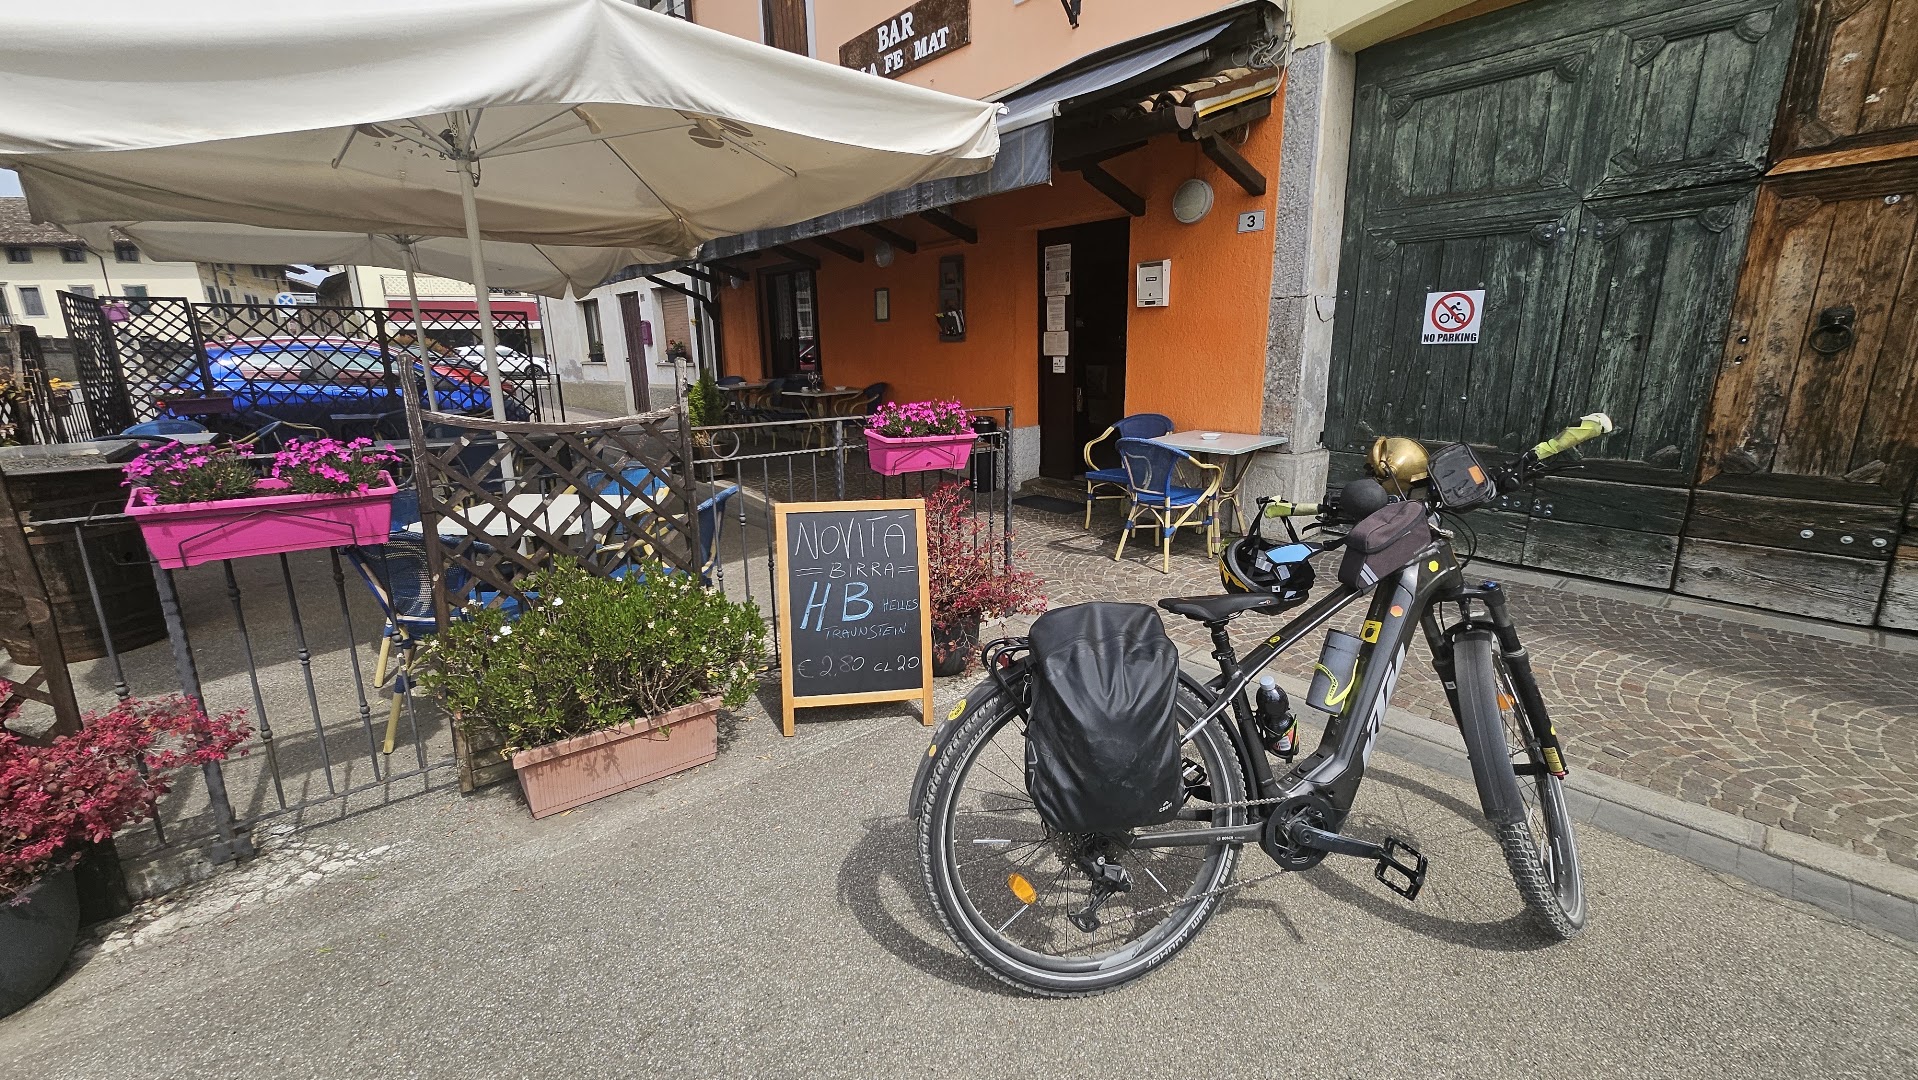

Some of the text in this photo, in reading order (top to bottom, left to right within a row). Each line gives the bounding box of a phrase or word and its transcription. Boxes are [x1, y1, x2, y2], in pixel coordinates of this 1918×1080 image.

[877, 11, 915, 52] BAR
[1247, 215, 1256, 228] 3
[1423, 332, 1477, 343] NO PARKING
[883, 598, 919, 613] HELLES
[823, 622, 907, 640] TRAUNSTEIN
[897, 654, 920, 672] 20
